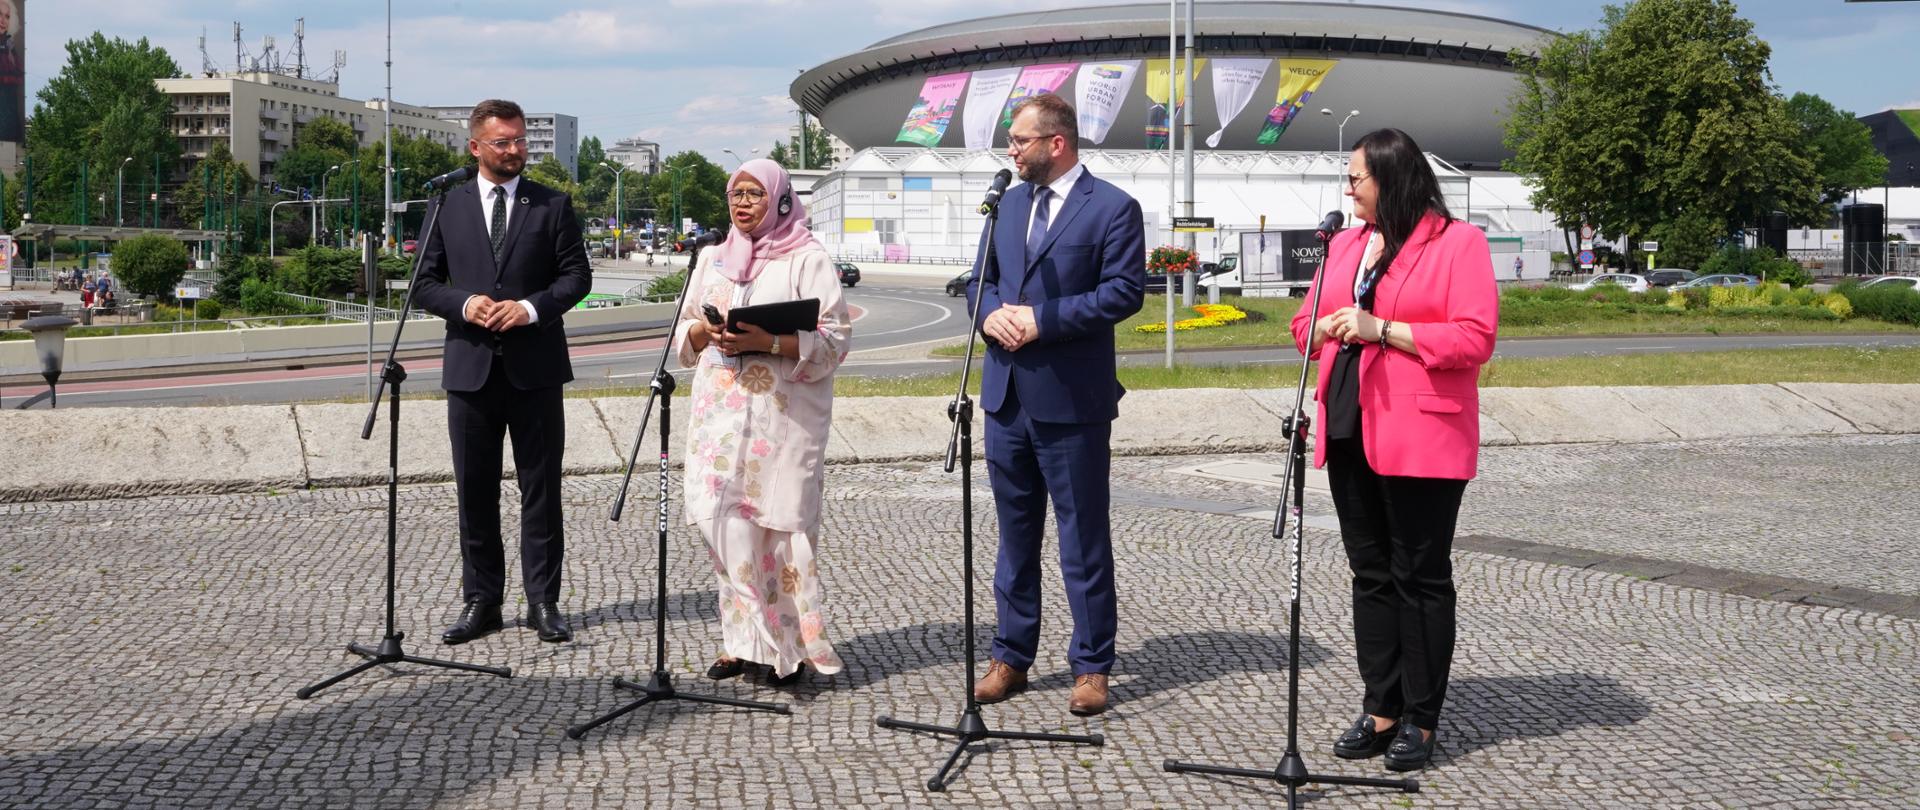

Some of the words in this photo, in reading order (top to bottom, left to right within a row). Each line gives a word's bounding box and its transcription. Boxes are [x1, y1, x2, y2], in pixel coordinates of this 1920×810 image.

[1089, 80, 1117, 93] WORLD
[1086, 94, 1112, 107] FORUM
[1087, 87, 1114, 101] URBAN
[1291, 516, 1299, 600] DYNAWID
